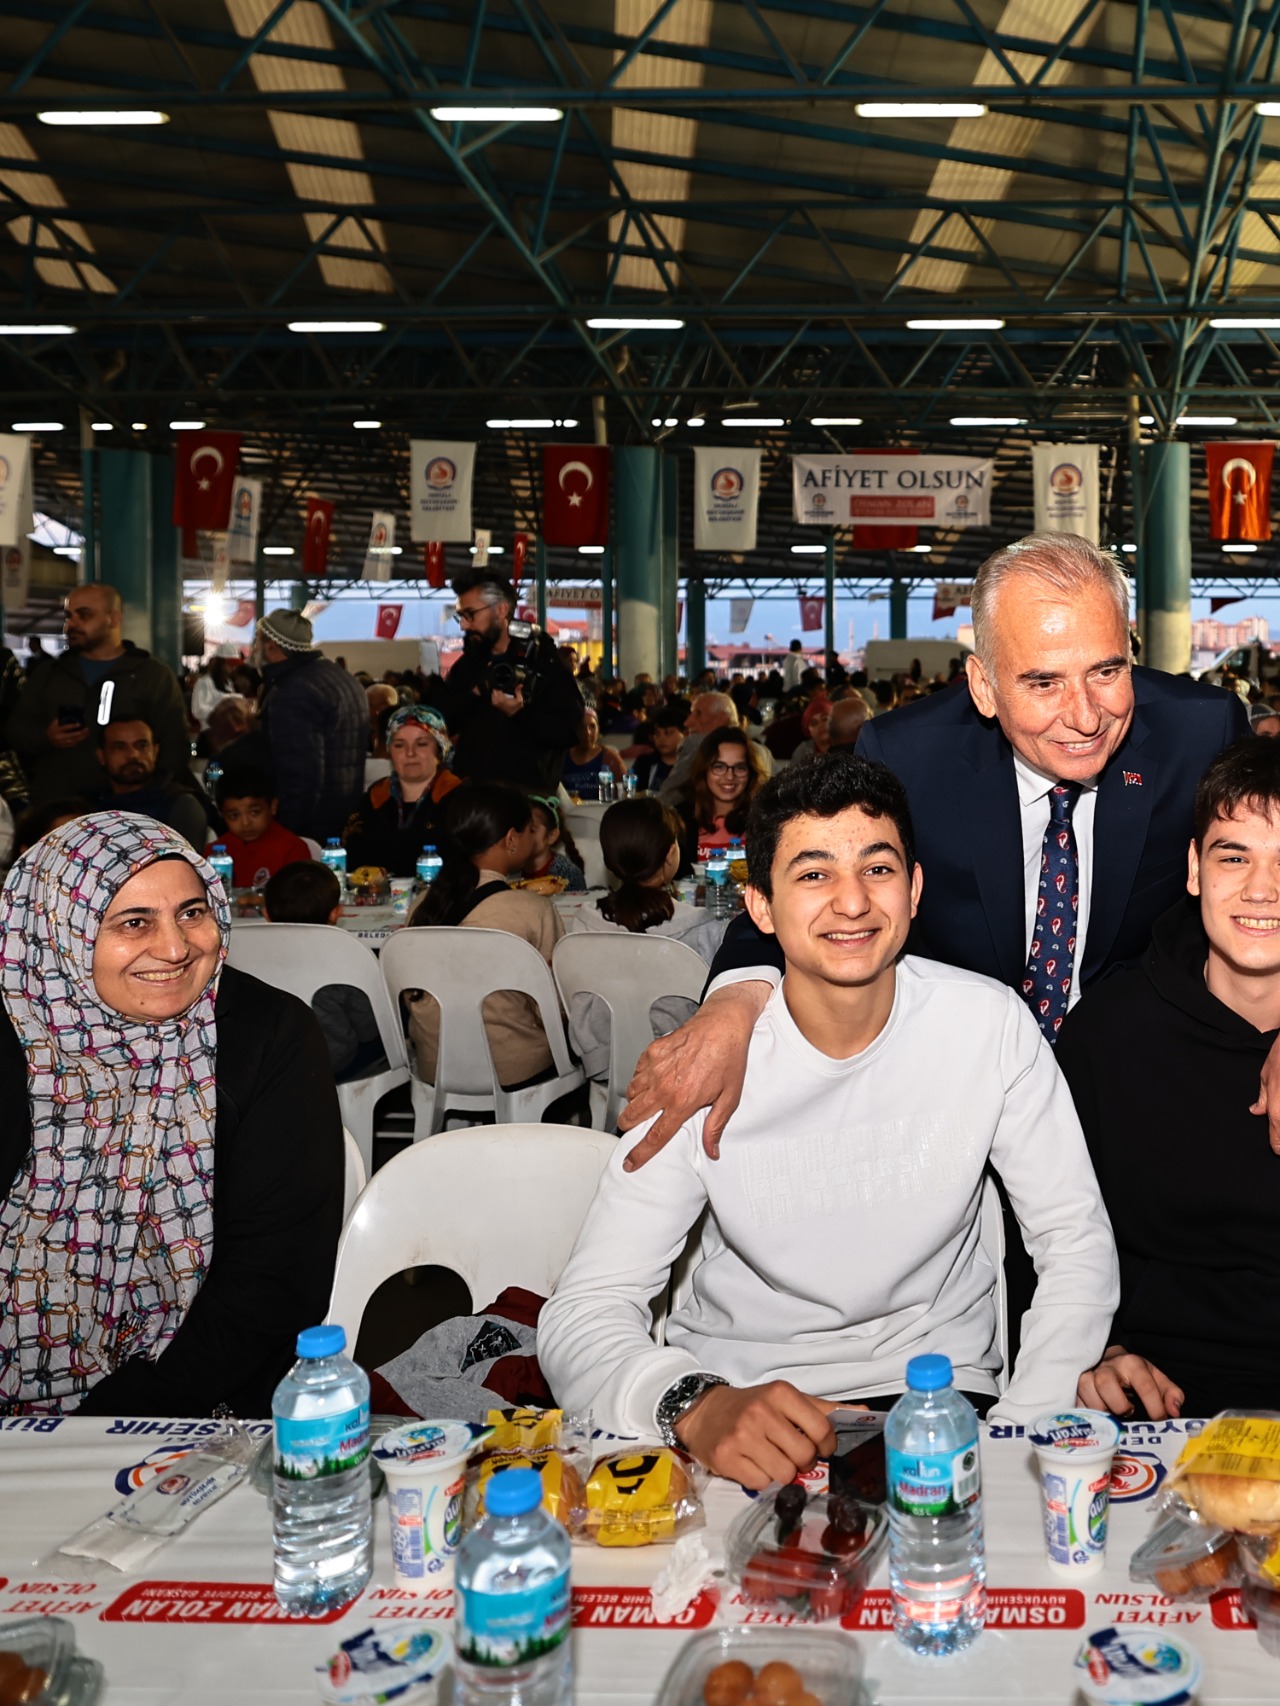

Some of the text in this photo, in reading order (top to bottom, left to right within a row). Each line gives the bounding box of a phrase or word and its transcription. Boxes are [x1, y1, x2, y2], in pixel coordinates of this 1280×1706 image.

[803, 465, 984, 488] AFİYET OLSUN
[900, 1479, 947, 1497] Madran
[122, 1599, 217, 1617] ZOLAN
[1094, 1593, 1175, 1606] OLSUN
[1111, 1611, 1202, 1627] AFİYET
